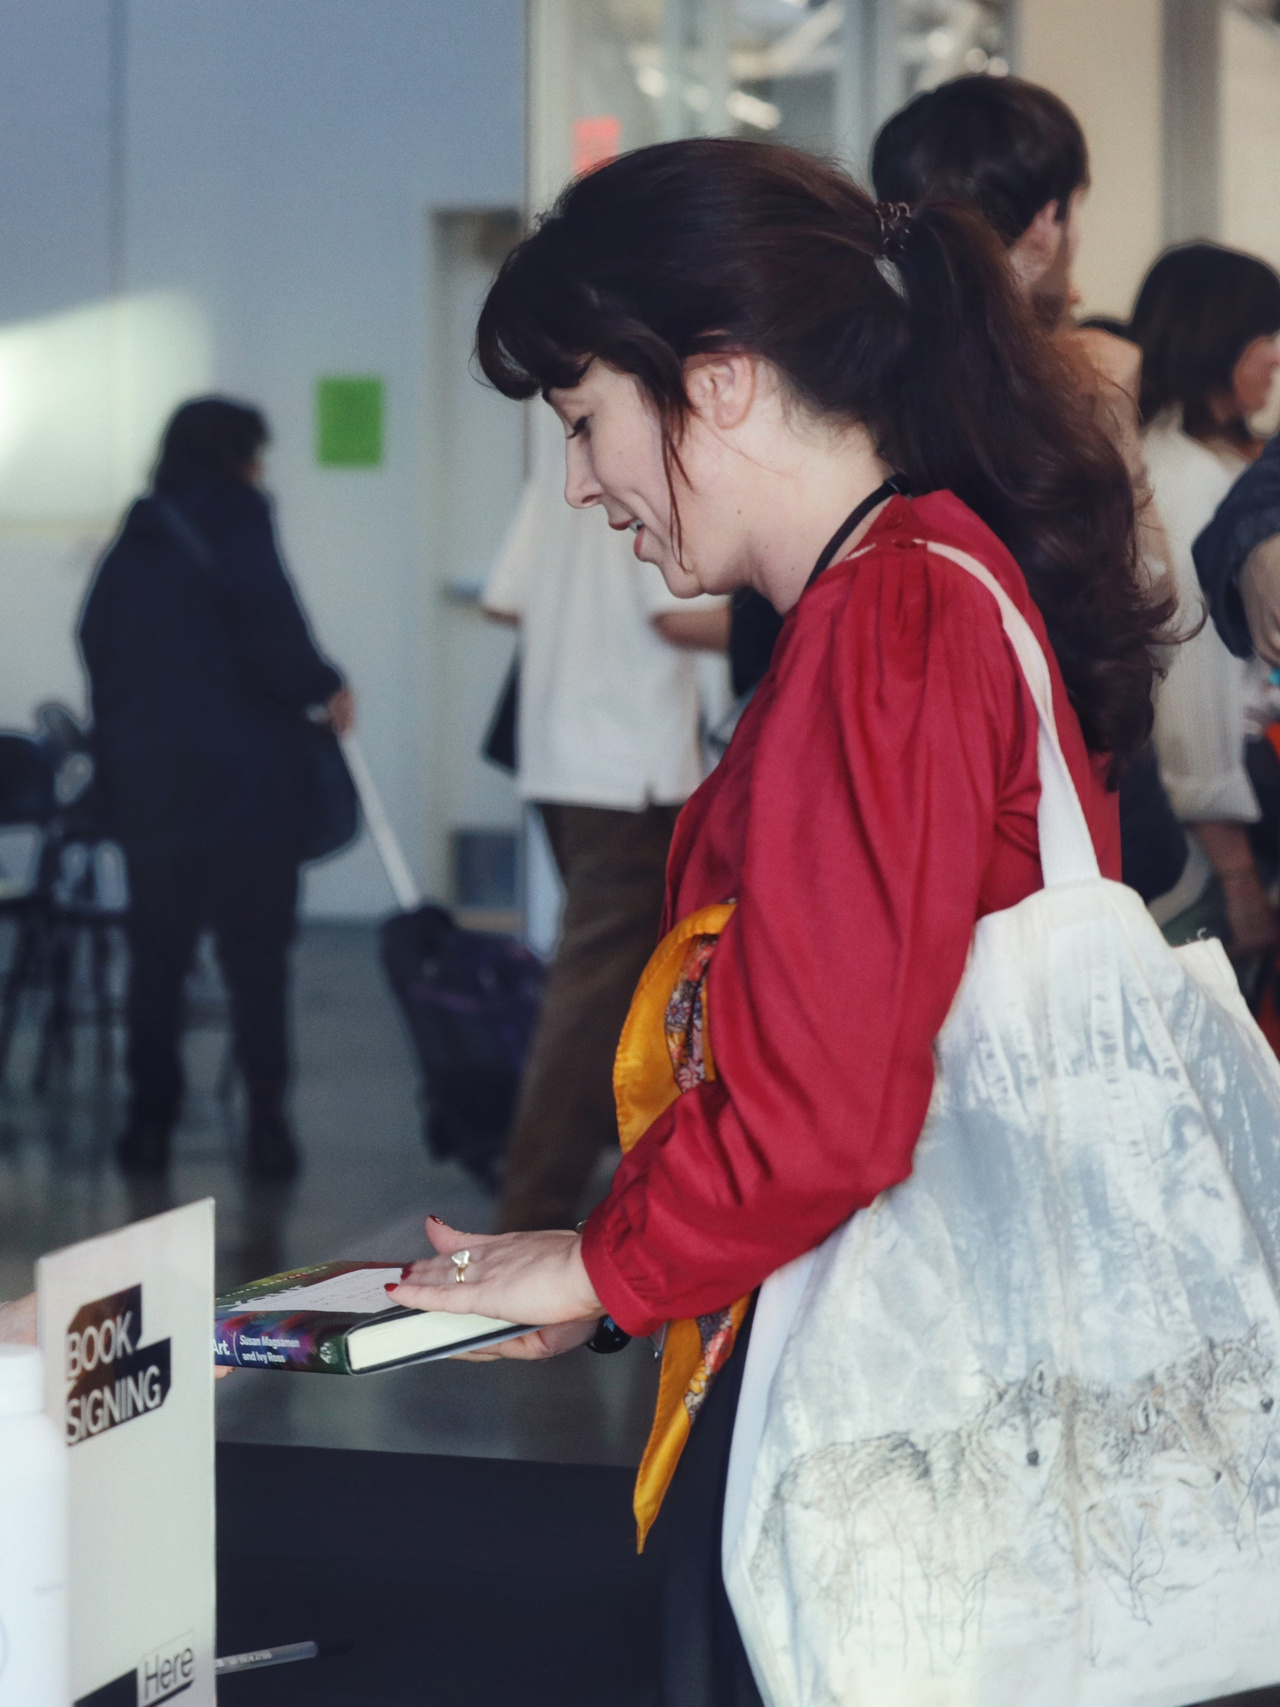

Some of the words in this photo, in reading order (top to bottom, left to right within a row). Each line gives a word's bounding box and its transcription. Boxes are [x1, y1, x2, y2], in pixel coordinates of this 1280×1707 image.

[67, 1310, 133, 1380] BOOK
[239, 1335, 261, 1346] Susan
[242, 1351, 256, 1361] and
[256, 1352, 267, 1363] Ivy
[267, 1352, 286, 1362] Ross
[67, 1365, 161, 1443] SIGNING
[144, 1647, 194, 1699] Here
